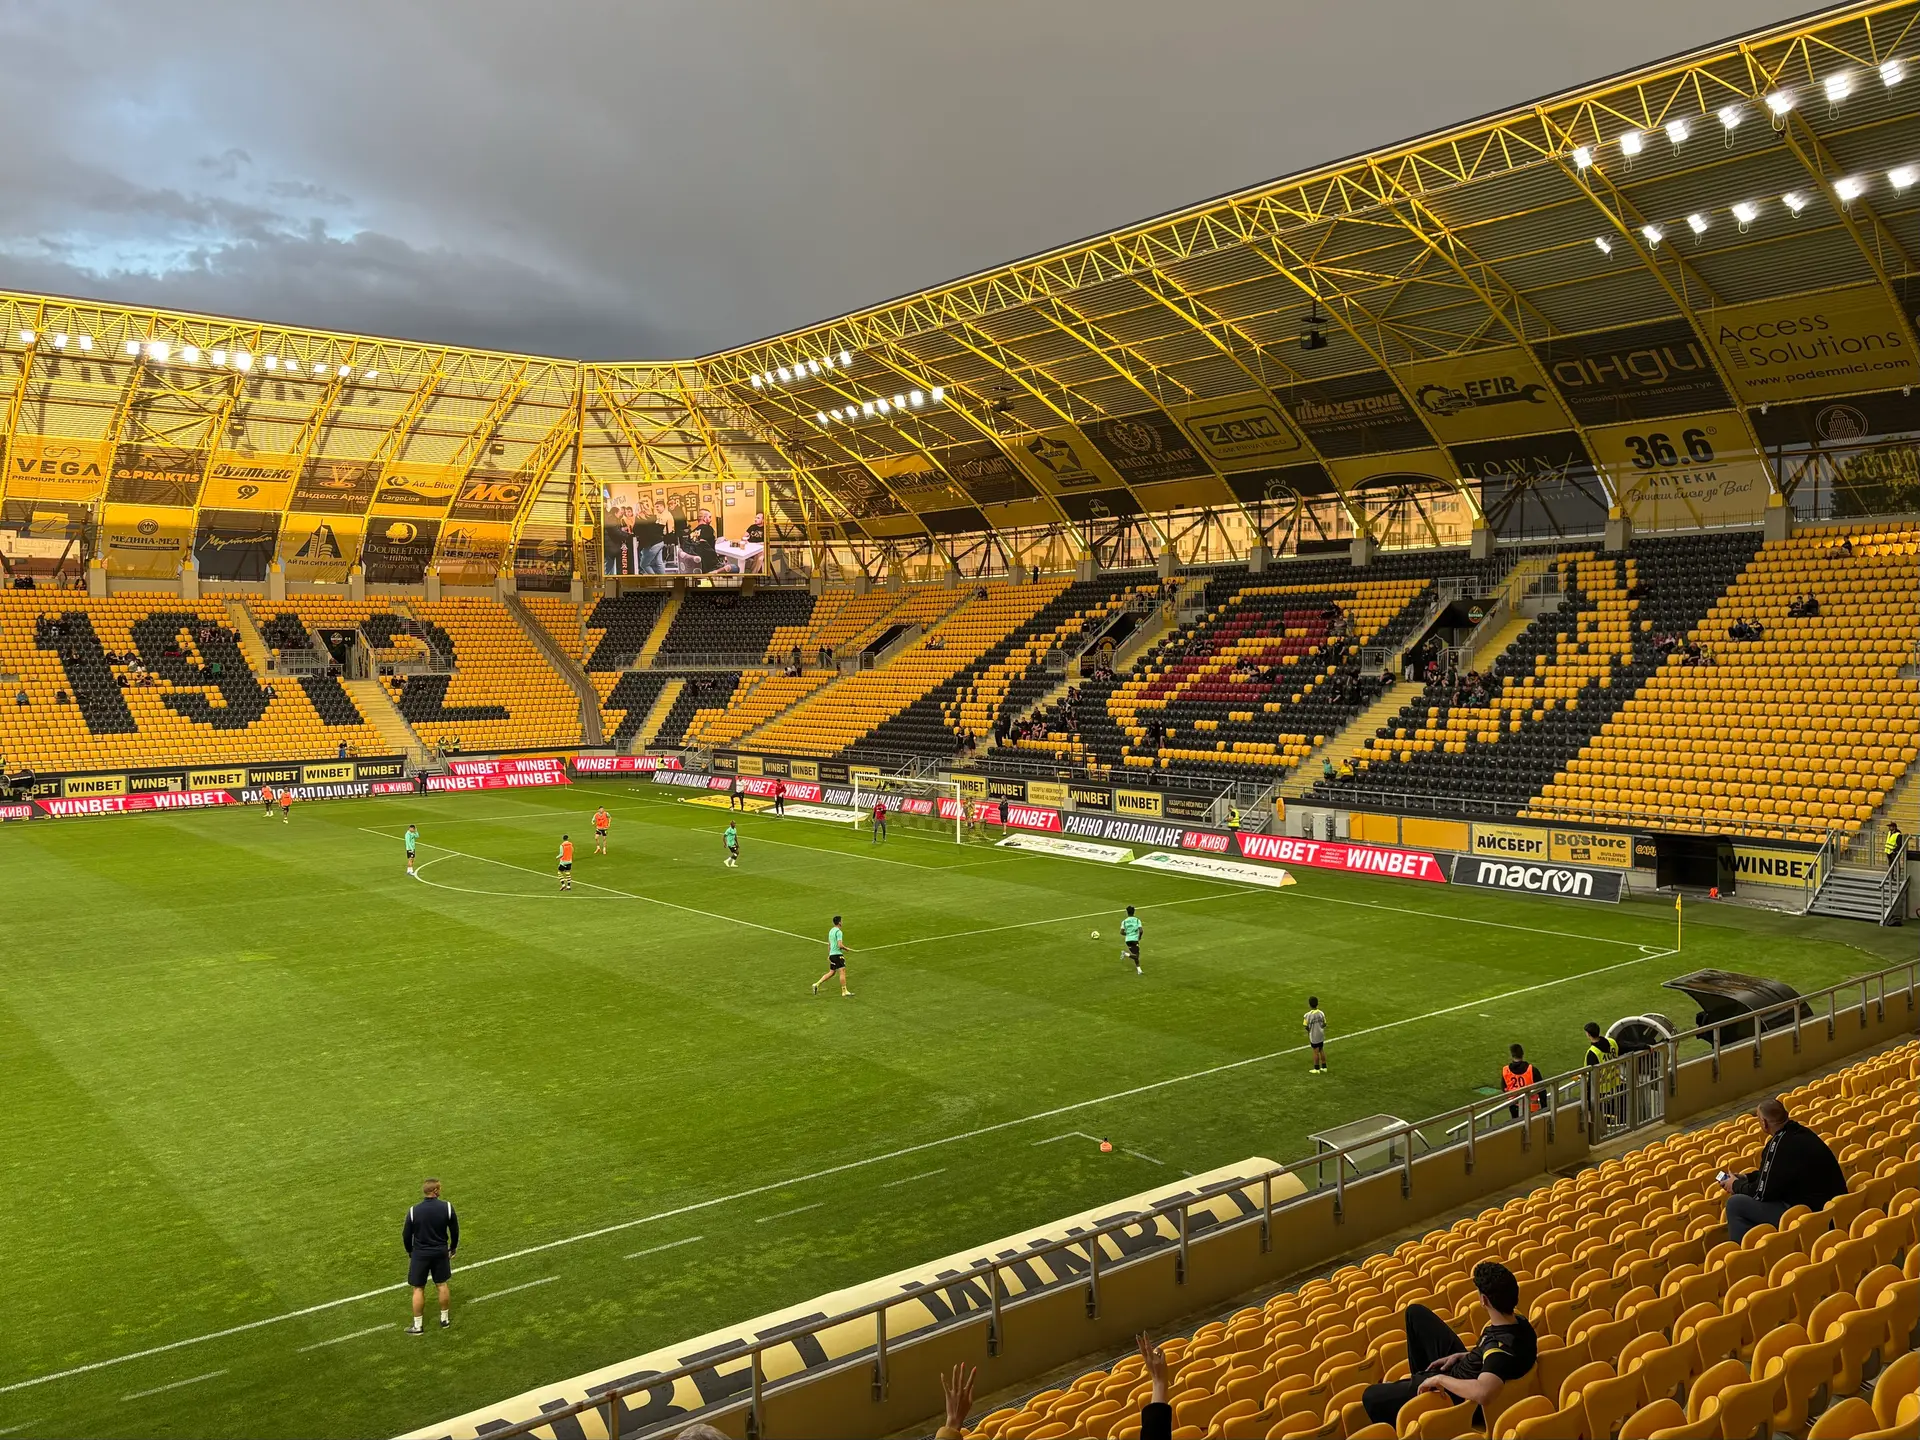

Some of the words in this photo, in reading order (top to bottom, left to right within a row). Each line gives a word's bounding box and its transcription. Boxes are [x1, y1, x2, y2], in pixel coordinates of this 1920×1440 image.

[1719, 313, 1829, 345] Access
[1749, 331, 1902, 366] Solutions
[1464, 376, 1519, 400] EFIR
[1311, 393, 1400, 418] MAXSTONE
[1205, 418, 1277, 444] Z&M
[1625, 429, 1714, 469] 36.6
[1115, 455, 1152, 469] MAGIC
[1151, 447, 1193, 464] FLAME
[17, 458, 101, 477] VEGA
[1463, 455, 1556, 478] TOWN
[12, 474, 55, 483] PREMIUM
[58, 477, 100, 485] BATTERY
[132, 471, 200, 483] PRAKTIS
[1264, 478, 1286, 488] МБАЛ
[1649, 471, 1717, 487] АПТЕКИ
[434, 481, 455, 489] Blue
[462, 483, 522, 502] MC
[297, 490, 338, 501] Видекс
[339, 493, 369, 502] Армс
[382, 494, 420, 502] CargoLine
[110, 535, 180, 546] МЕДИНА-МЕД
[443, 550, 500, 559] RESIDENCE
[518, 559, 570, 570] TITAN
[358, 765, 402, 776] WINBET
[455, 762, 500, 775] WINBET
[515, 759, 559, 772] WINBET
[577, 758, 620, 769] WINBET
[634, 758, 677, 769] WINET
[715, 758, 737, 769] WINBET
[765, 762, 789, 774] WINBET
[792, 765, 817, 776] WINBET
[192, 774, 242, 786] WINBET
[250, 771, 298, 783] WINBET
[306, 768, 351, 779] WINBET
[426, 776, 485, 789] WINBET
[505, 771, 561, 786] WINBET
[2, 782, 58, 797] WBET
[69, 780, 122, 793] WINBET
[374, 783, 388, 793] НА
[388, 781, 413, 792] ЖИВО
[952, 779, 985, 792] WINBET
[989, 783, 1024, 796] WINBET
[50, 797, 127, 815] WINBET
[154, 791, 225, 808] WINBET
[824, 788, 851, 806] РАННО
[1071, 789, 1110, 806] WINBET
[1118, 794, 1159, 810] WINBET
[1008, 808, 1057, 828] WINBET
[1065, 815, 1103, 837] РАННО
[1103, 820, 1183, 847] ИЗПЛАЩАНЕ
[1184, 833, 1197, 847] НА
[1198, 835, 1228, 851] ЖИВО
[1477, 834, 1543, 853] АЙСБЕРГ
[1243, 836, 1319, 862] WINBET
[1346, 848, 1434, 877] WINBET
[1600, 851, 1627, 859] BUILDING
[1477, 861, 1593, 896] macron
[1511, 1076, 1525, 1088] 20
[900, 1176, 1258, 1323] WINBET
